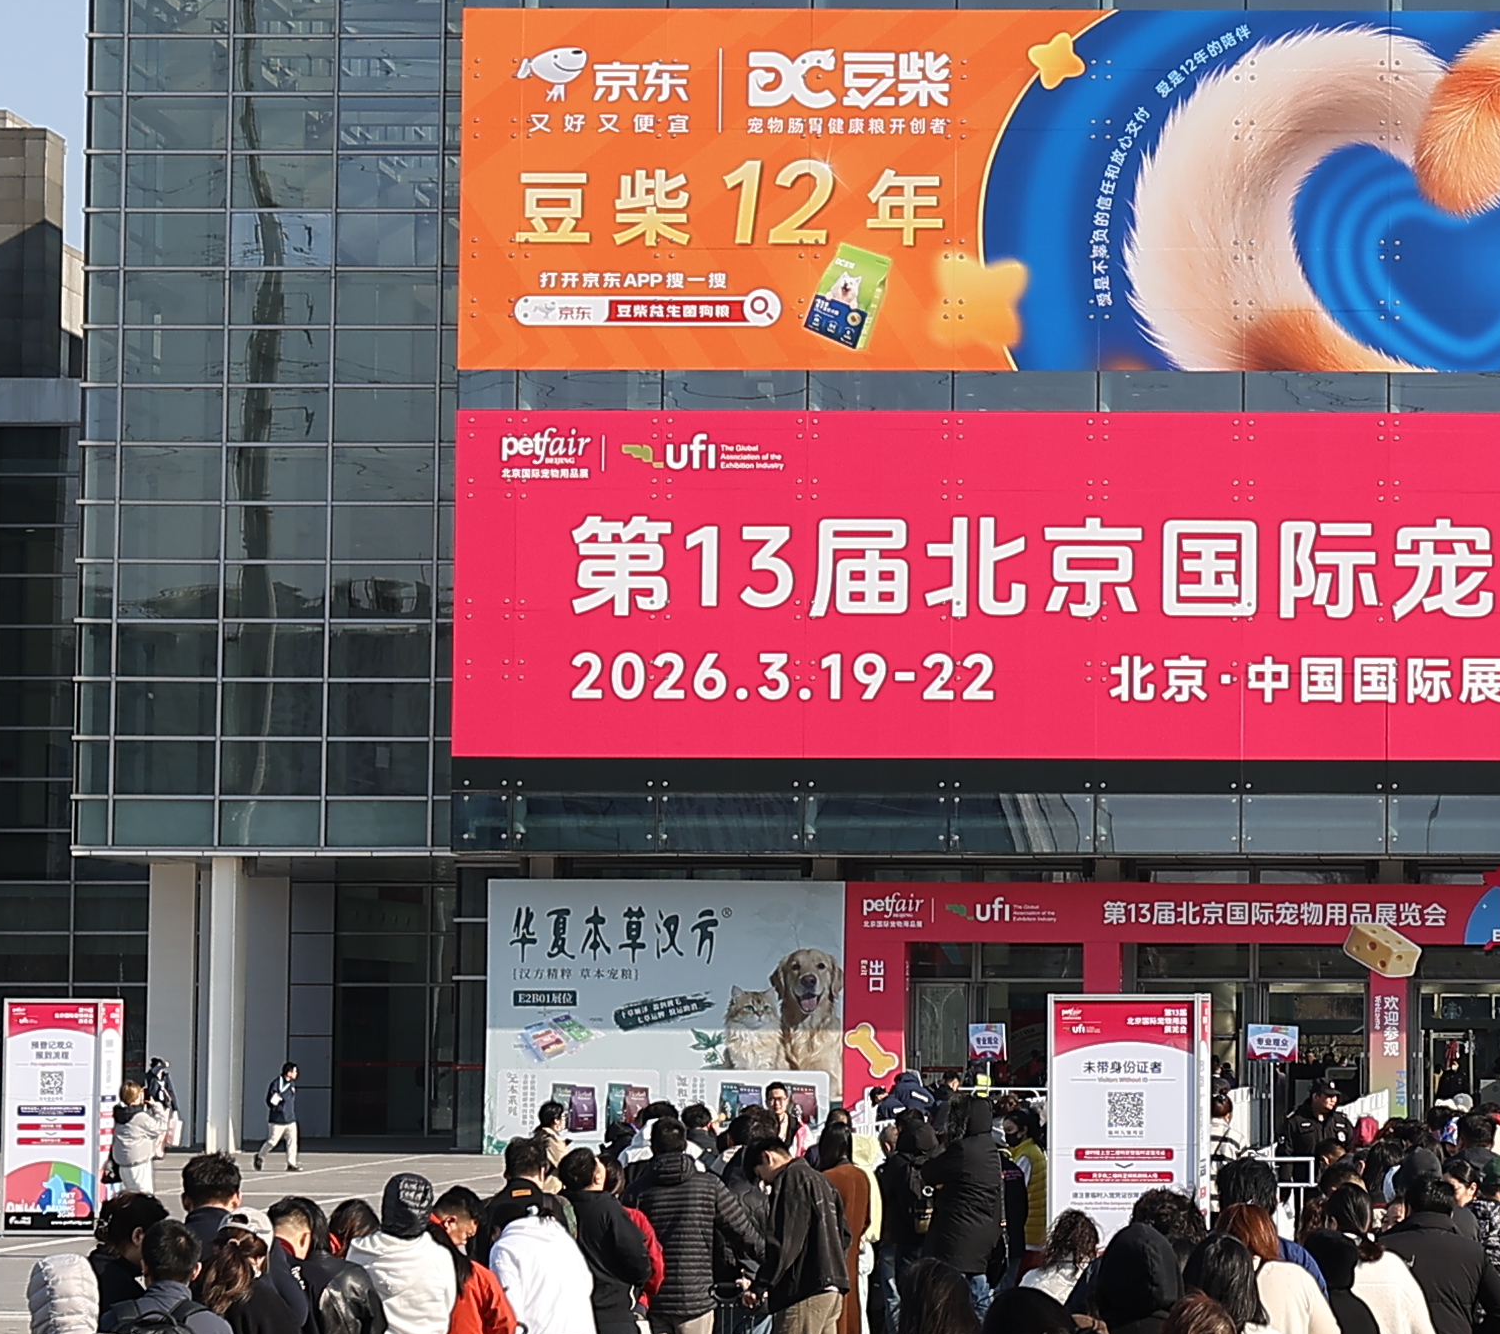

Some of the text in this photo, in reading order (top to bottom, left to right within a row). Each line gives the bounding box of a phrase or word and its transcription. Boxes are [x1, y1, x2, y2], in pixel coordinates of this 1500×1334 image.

[1155, 23, 1252, 98] 爱是12年的陪伴
[593, 62, 690, 102] 京东
[529, 113, 690, 134] 又好又便宜
[747, 117, 947, 135] 宠物肠胃健康粮开创者
[1092, 106, 1151, 307] 爱是不辜负的信任和放心交付
[539, 271, 727, 288] 打开京东APP搜一搜
[558, 305, 593, 320] 京东
[616, 304, 731, 319] 豆柴益生菌狗粮
[501, 427, 591, 464] petfair
[665, 433, 717, 470] ufi
[501, 468, 590, 479] 北京国际宠物用品展
[570, 652, 996, 702] 2026.3.19-22
[863, 892, 924, 918] petfair
[975, 897, 1010, 921] ufi
[1103, 900, 1447, 927] 第13届北京国际宠物用品展览会
[509, 905, 720, 965] 华夏本草汉方
[869, 960, 884, 992] 出口
[518, 993, 574, 1005] E2B01展位
[1383, 996, 1399, 1057] 欢迎参观
[31, 1040, 73, 1050] 预登记观众
[1257, 1037, 1289, 1046] 专业观众
[1083, 1061, 1162, 1074] 未带身份证者
